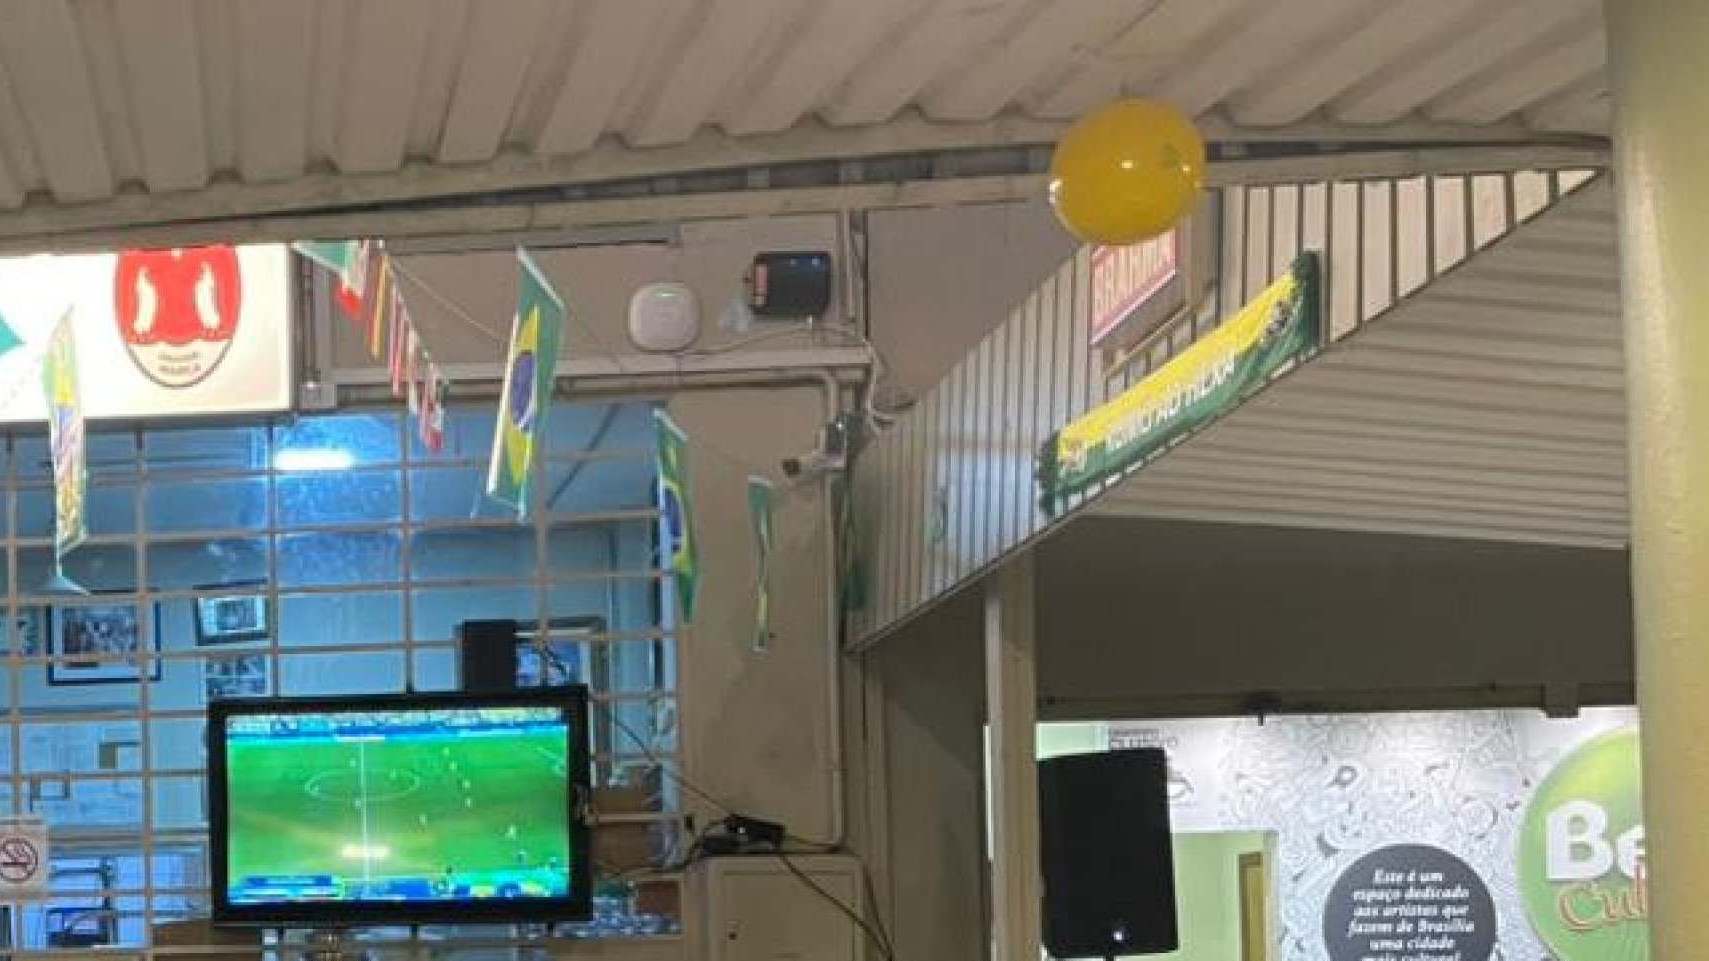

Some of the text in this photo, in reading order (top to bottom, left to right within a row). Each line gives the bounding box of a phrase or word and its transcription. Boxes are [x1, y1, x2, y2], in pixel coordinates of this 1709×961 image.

[1373, 868, 1405, 884] Este
[1420, 872, 1444, 883] um
[1352, 884, 1469, 903] espaço dedicado
[1353, 902, 1469, 919] aos artistas que
[1346, 919, 1392, 939] fazem
[1396, 919, 1414, 933] de
[1369, 934, 1456, 950] uma cidade
